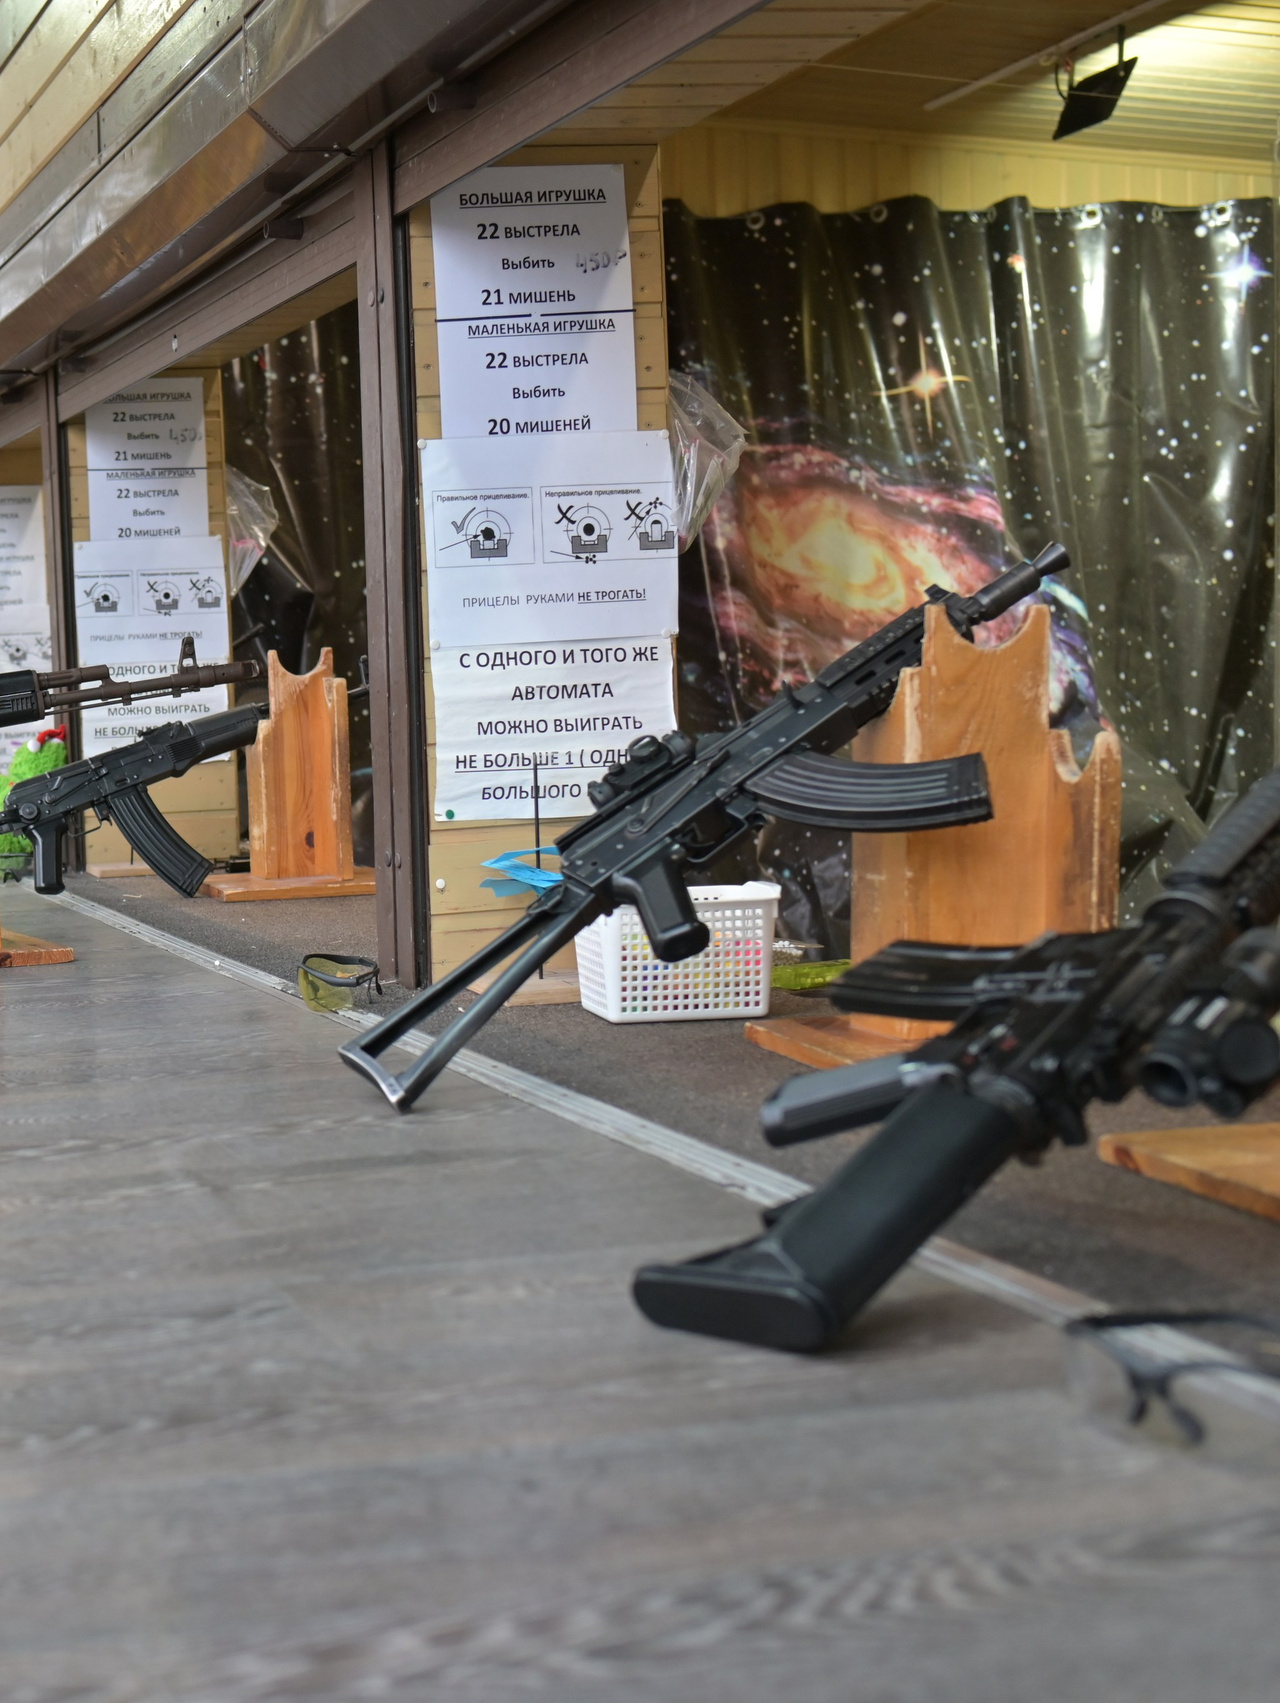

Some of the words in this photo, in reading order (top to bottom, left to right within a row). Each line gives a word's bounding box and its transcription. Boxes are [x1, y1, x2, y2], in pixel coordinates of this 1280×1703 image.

[459, 190, 533, 207] БОЛЬШАЯ
[537, 188, 606, 203] ИГРУШКА
[476, 223, 500, 240] 22
[504, 224, 581, 239] ВЫСТРЕЛА
[501, 257, 555, 270] Выбить
[481, 289, 504, 306] 21
[508, 290, 576, 305] МИШЕНЬ
[468, 321, 550, 336] МАЛЕНЬКАЯ
[553, 318, 616, 332] ИГРУШКА
[485, 352, 508, 369] 22
[513, 353, 588, 368] ВЫСТРЕЛА
[149, 392, 191, 401] ИГРУШКА
[512, 386, 566, 399] Выбить
[112, 412, 127, 422] 22
[128, 413, 176, 422] ВЫСТРЕЛА
[488, 418, 511, 436] 20
[515, 415, 592, 434] МИШЕНЕЙ
[127, 432, 160, 440] Выбить
[114, 451, 128, 461] 21
[131, 452, 172, 461] МИШЕНЬ
[106, 471, 156, 479] МАЛЕНЬКАЯ
[158, 469, 196, 478] ИГРУШКА
[117, 489, 131, 499] 22
[133, 489, 180, 498] ВЫСТРЕЛА
[436, 495, 478, 503] Правильное
[545, 490, 593, 498] Неправильное
[133, 509, 165, 517] Выбить
[118, 528, 132, 538] 20
[134, 526, 181, 537] МИШЕНЕЙ
[463, 595, 520, 609] ПРИЦЕЛЫ
[526, 592, 575, 605] РУКАМИ
[577, 591, 593, 602] НЕ
[594, 588, 647, 601] ТРОГАТЬ!
[90, 634, 125, 643] ПРИЦЕЛЫ
[128, 633, 157, 641] РУКАМИ
[159, 632, 168, 640] НЕ
[459, 653, 470, 668] С
[476, 650, 557, 670] ОДНОГО
[562, 649, 575, 664] И
[580, 647, 627, 663] ТОГО
[632, 646, 659, 661] ЖЕ
[159, 665, 167, 674] И
[511, 682, 614, 701] АВТОМАТА
[108, 706, 151, 716] МОЖНО
[155, 704, 210, 714] ВЫИГРАТЬ
[477, 719, 548, 736] МОЖНО
[554, 715, 643, 733] ВЫИГРАТЬ
[95, 727, 108, 737] НЕ
[455, 755, 477, 770] НЕ
[483, 751, 559, 768] БОЛЬШЕ
[565, 750, 574, 765] 1
[590, 749, 628, 767] ОДН
[481, 783, 582, 801] БОЛЬШОГО
